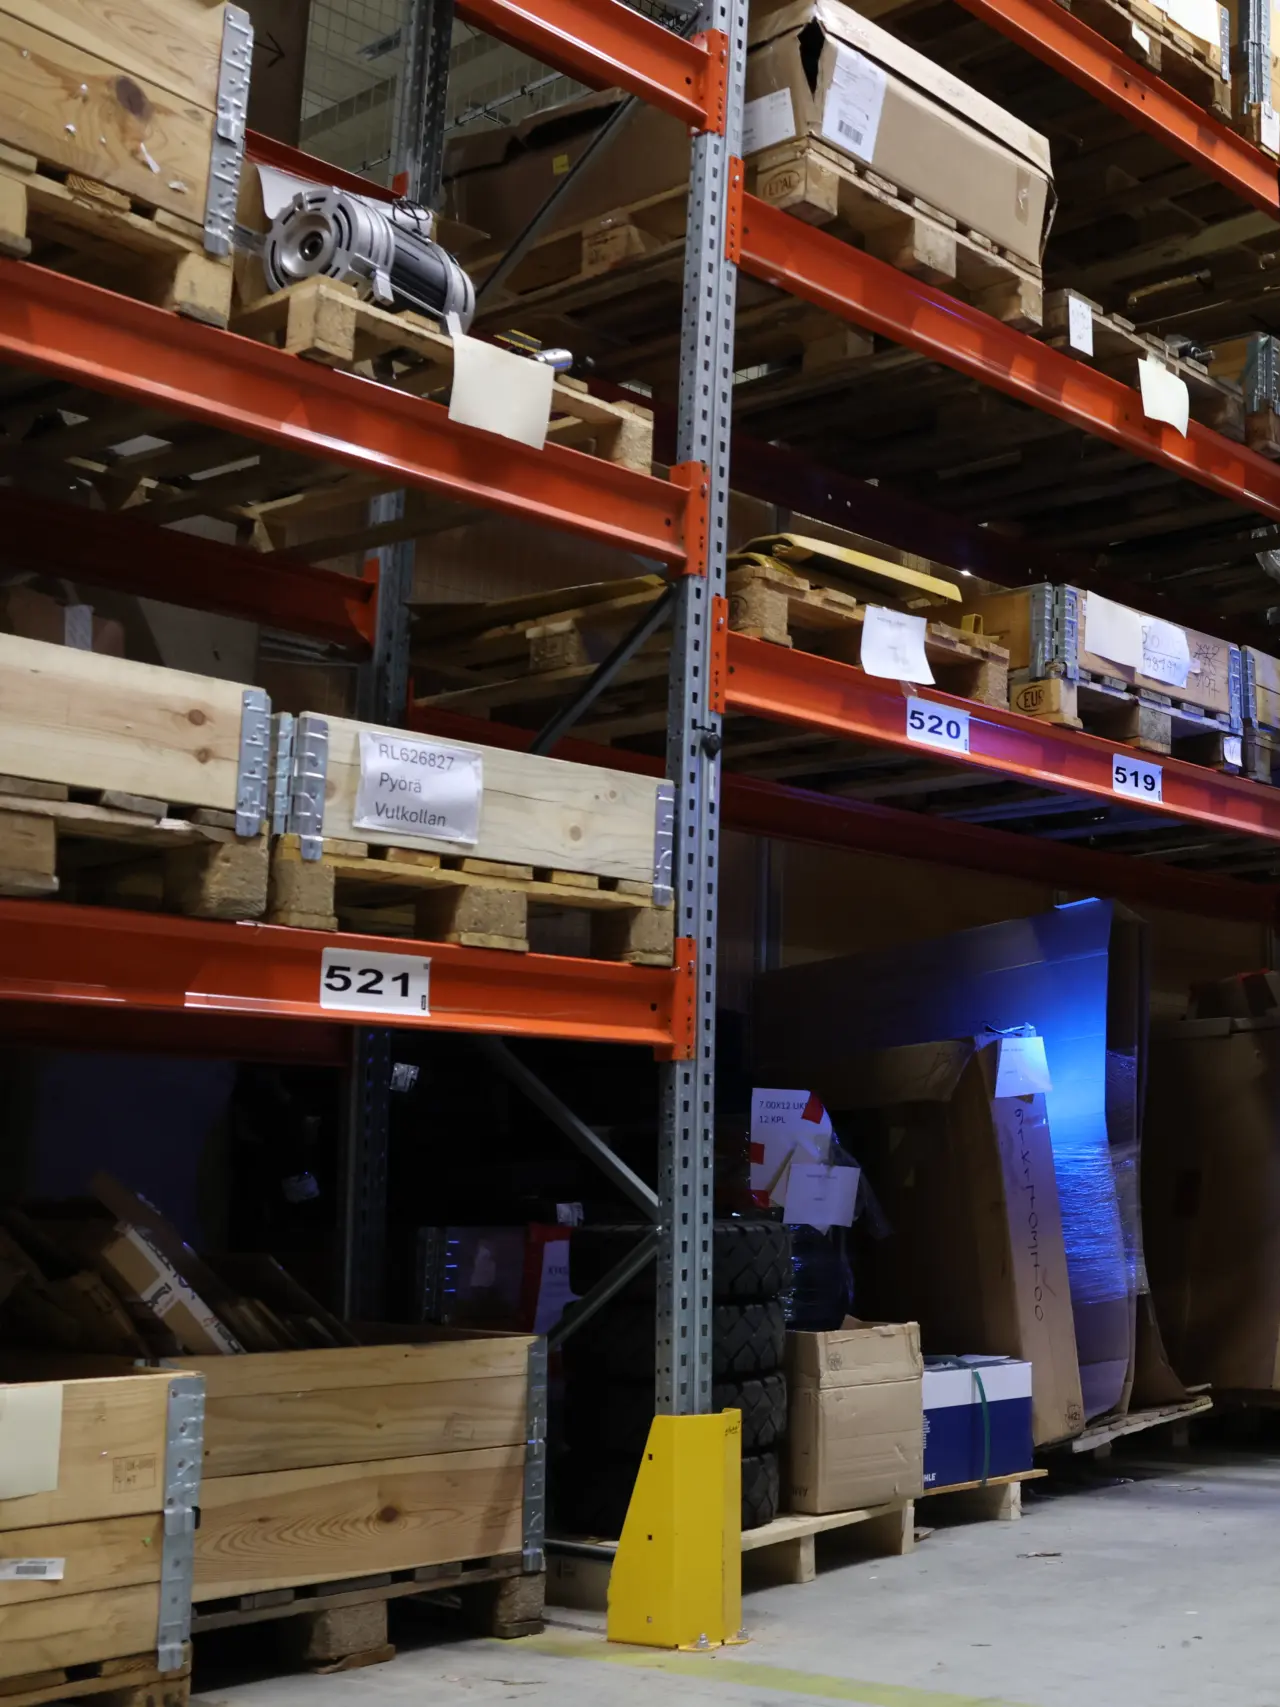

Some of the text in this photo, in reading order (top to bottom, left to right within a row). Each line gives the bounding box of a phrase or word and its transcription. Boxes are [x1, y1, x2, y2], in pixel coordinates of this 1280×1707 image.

[909, 710, 960, 739] 520
[379, 743, 454, 771] RL626827
[379, 772, 422, 793] Pyörä
[1115, 766, 1155, 791] 519
[375, 801, 447, 827] Vulkollan
[324, 965, 409, 997] 521
[760, 1115, 769, 1123] 12
